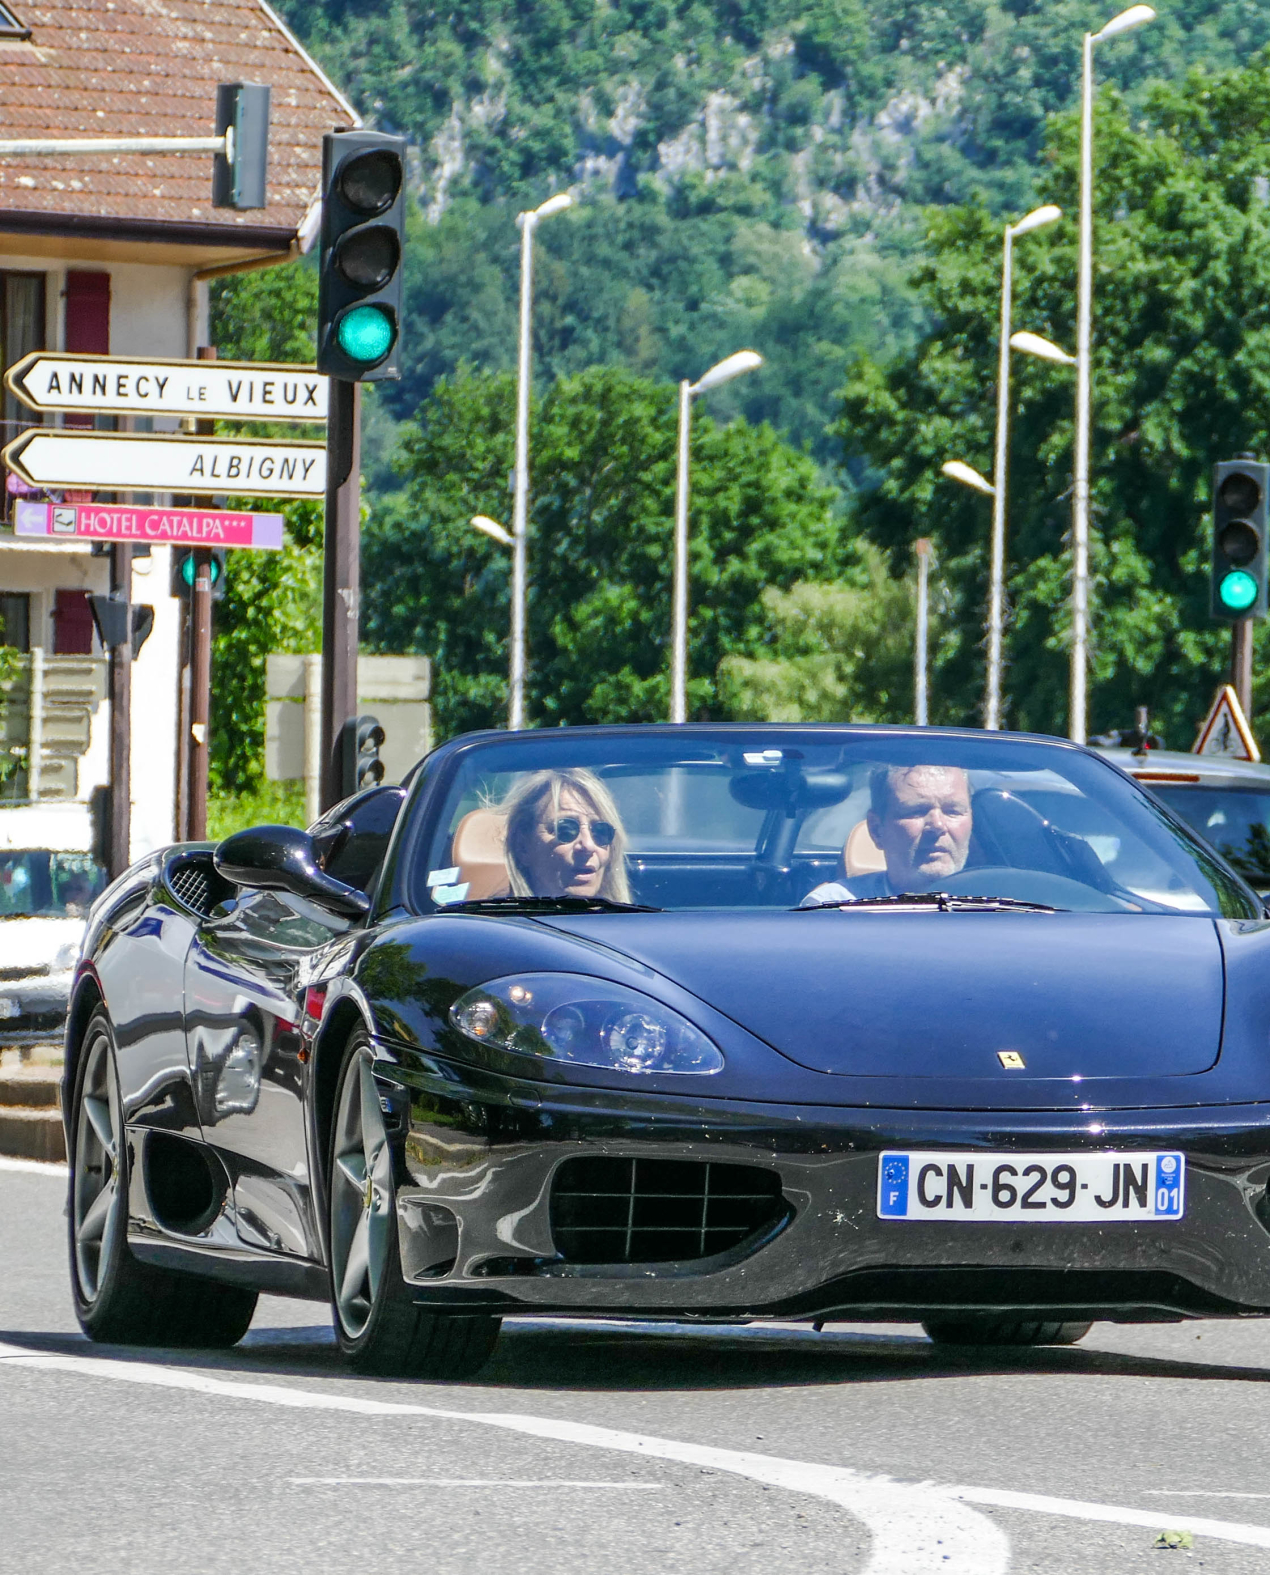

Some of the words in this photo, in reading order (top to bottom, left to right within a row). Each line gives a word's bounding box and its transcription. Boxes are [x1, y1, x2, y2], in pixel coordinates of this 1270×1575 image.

[47, 371, 169, 399] ANNECY
[186, 386, 207, 401] LE
[227, 379, 318, 406] VIEUX
[189, 454, 316, 481] ALBIGNY
[80, 512, 141, 535] HOTEL
[145, 514, 225, 539] CATALPA
[889, 1191, 899, 1206] F
[917, 1163, 1149, 1210] CN-629-JN
[1157, 1188, 1179, 1210] 01
